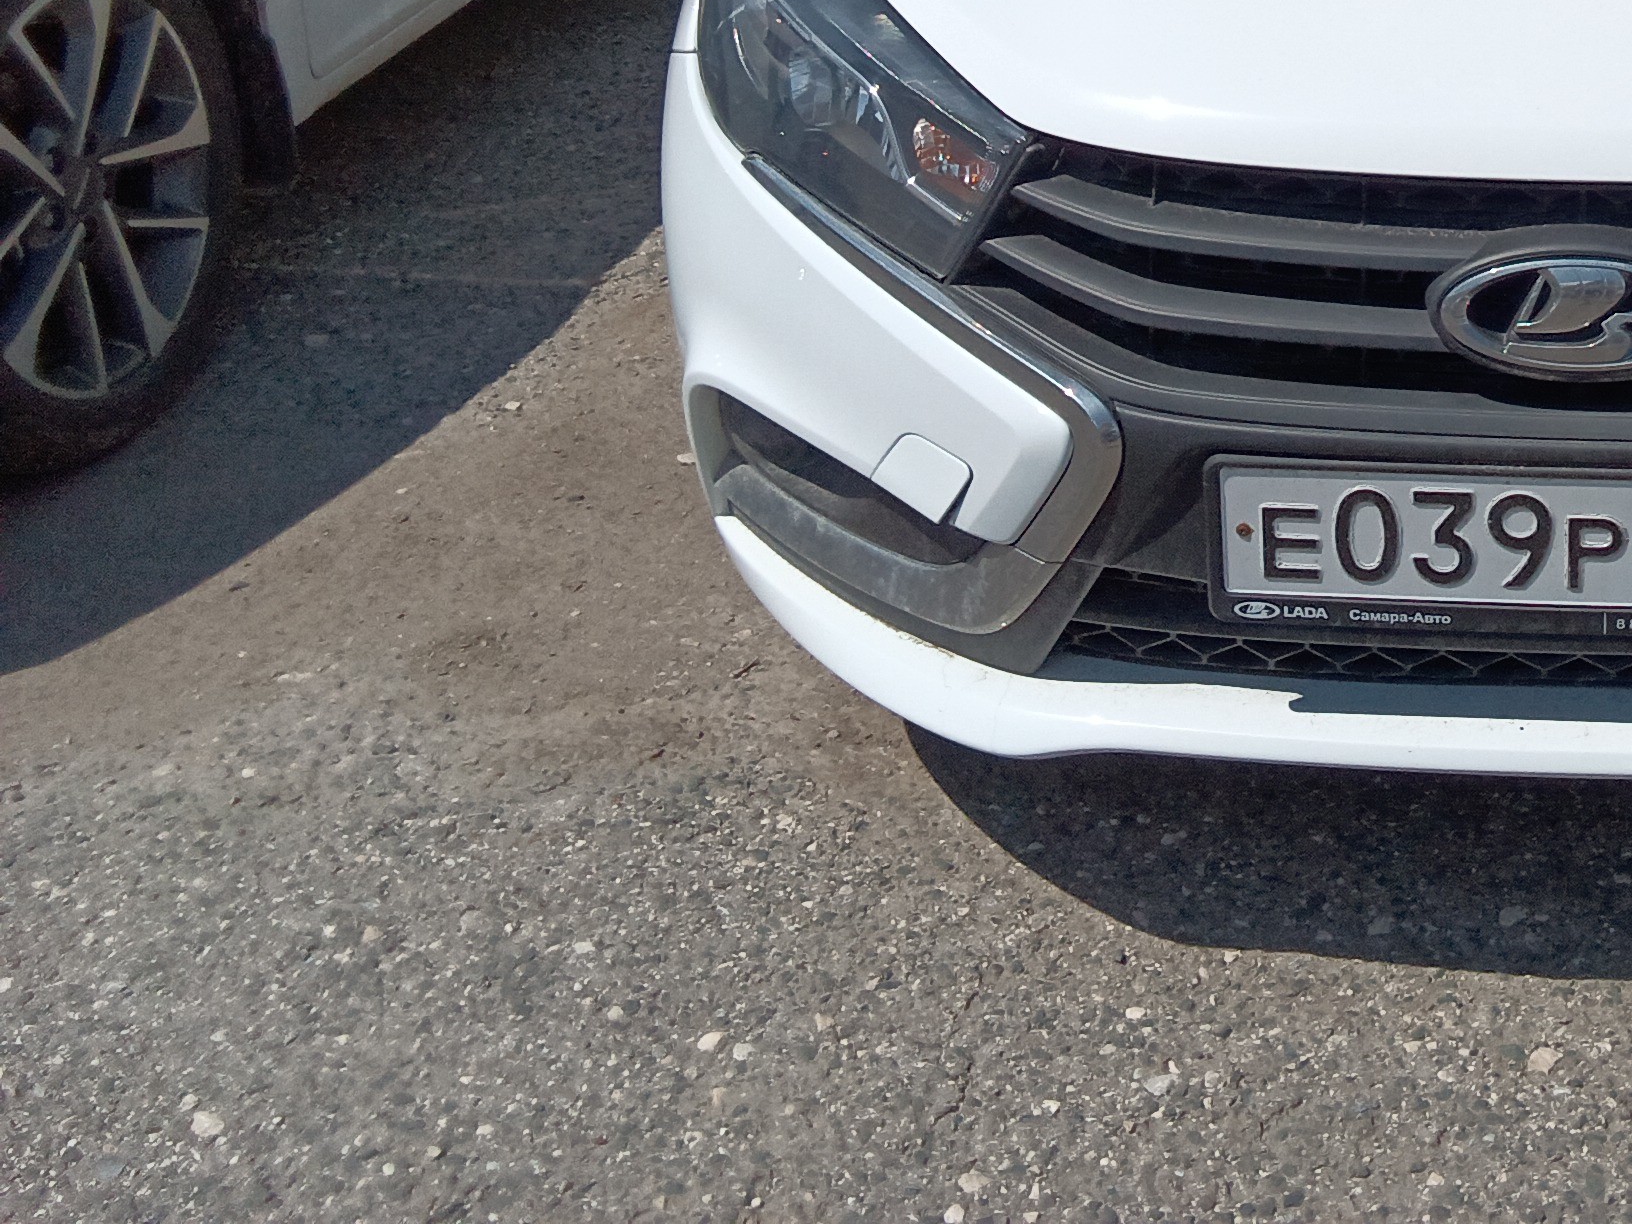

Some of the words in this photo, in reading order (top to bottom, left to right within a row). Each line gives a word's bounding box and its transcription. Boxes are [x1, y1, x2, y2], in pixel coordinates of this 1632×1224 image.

[1283, 606, 1329, 620] LADA
[1349, 609, 1452, 624] Самара-Авто
[1616, 618, 1626, 630] 8
